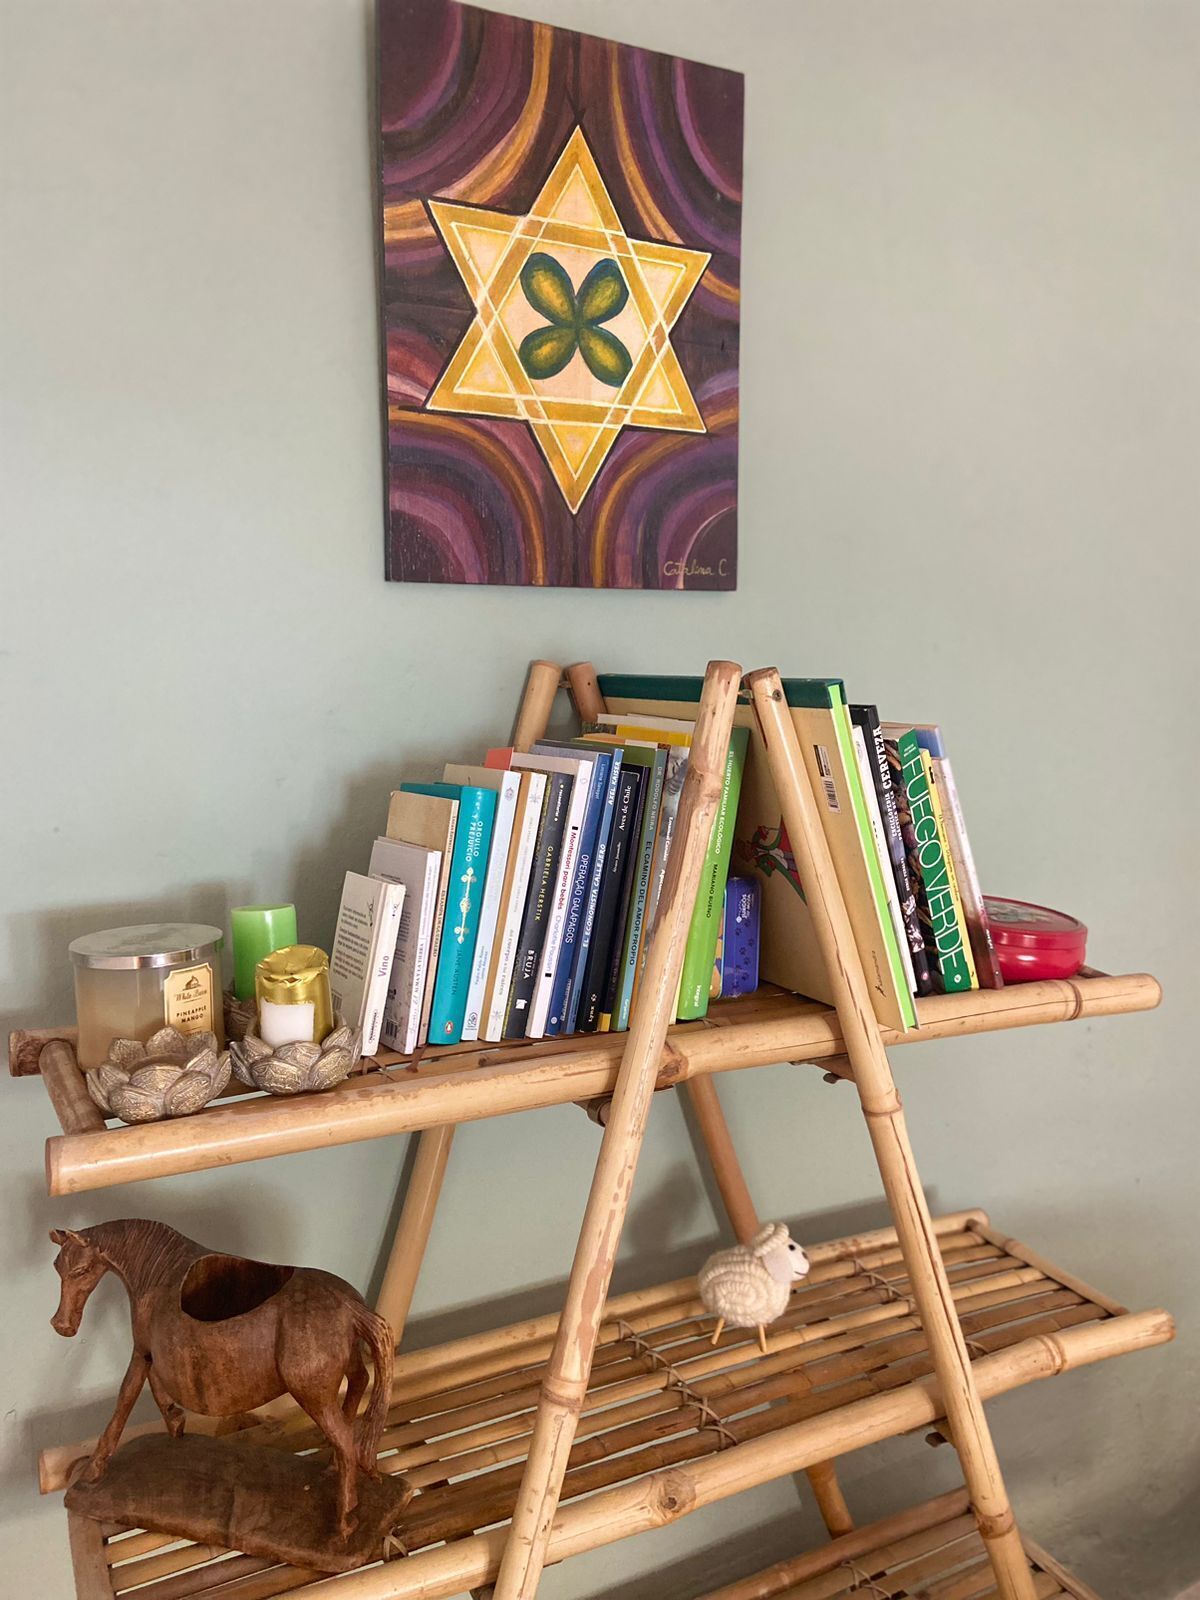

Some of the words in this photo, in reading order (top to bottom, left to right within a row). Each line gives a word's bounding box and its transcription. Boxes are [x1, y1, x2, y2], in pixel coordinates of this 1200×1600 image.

[664, 558, 713, 575] Catalina
[719, 559, 727, 576] C
[728, 751, 734, 759] EL
[873, 725, 893, 789] CERVEZA
[611, 760, 621, 786] KAISER
[725, 760, 733, 786] HUERTO
[608, 786, 616, 805] AXEL
[623, 785, 632, 804] Chile
[651, 779, 661, 810] RODOLFO
[720, 786, 730, 816] FAMILIAR
[890, 790, 894, 799] LA
[618, 815, 627, 831] Aves
[621, 805, 628, 814] de
[648, 811, 656, 831] NEIRA
[884, 792, 898, 837] ENCICLOPEDIA
[465, 822, 476, 862] PREJUICIO
[473, 820, 483, 857] ORGULLO
[645, 841, 652, 851] EL
[715, 817, 726, 855] ECOLÓGICO
[564, 831, 577, 870] Montessori
[541, 845, 553, 886] GABRIELA
[573, 853, 590, 897] OPERAÇÃO
[593, 843, 606, 887] CALLEJERO
[640, 853, 650, 887] CAMINO
[902, 755, 943, 868] FUEGO
[925, 866, 965, 975] VERDE
[560, 871, 569, 888] para
[709, 864, 719, 895] MARIANO
[535, 888, 546, 921] HERSTIK
[557, 889, 567, 911] bebés
[585, 888, 599, 936] ECONOMISTA
[706, 896, 714, 918] BUENO
[551, 914, 562, 945] Charlotte
[565, 896, 581, 944] GALÁPAGOS
[634, 907, 643, 932] AMOR
[504, 938, 512, 962] cuerpo
[583, 937, 590, 948] EL
[629, 933, 639, 966] PROPIO
[378, 955, 390, 977] Vino
[523, 949, 535, 980] BRUJA
[451, 968, 459, 996] AUSTEN
[693, 984, 702, 1007] Integral
[176, 1005, 207, 1017] PINEAPPLE
[181, 1013, 204, 1023] MANGO
